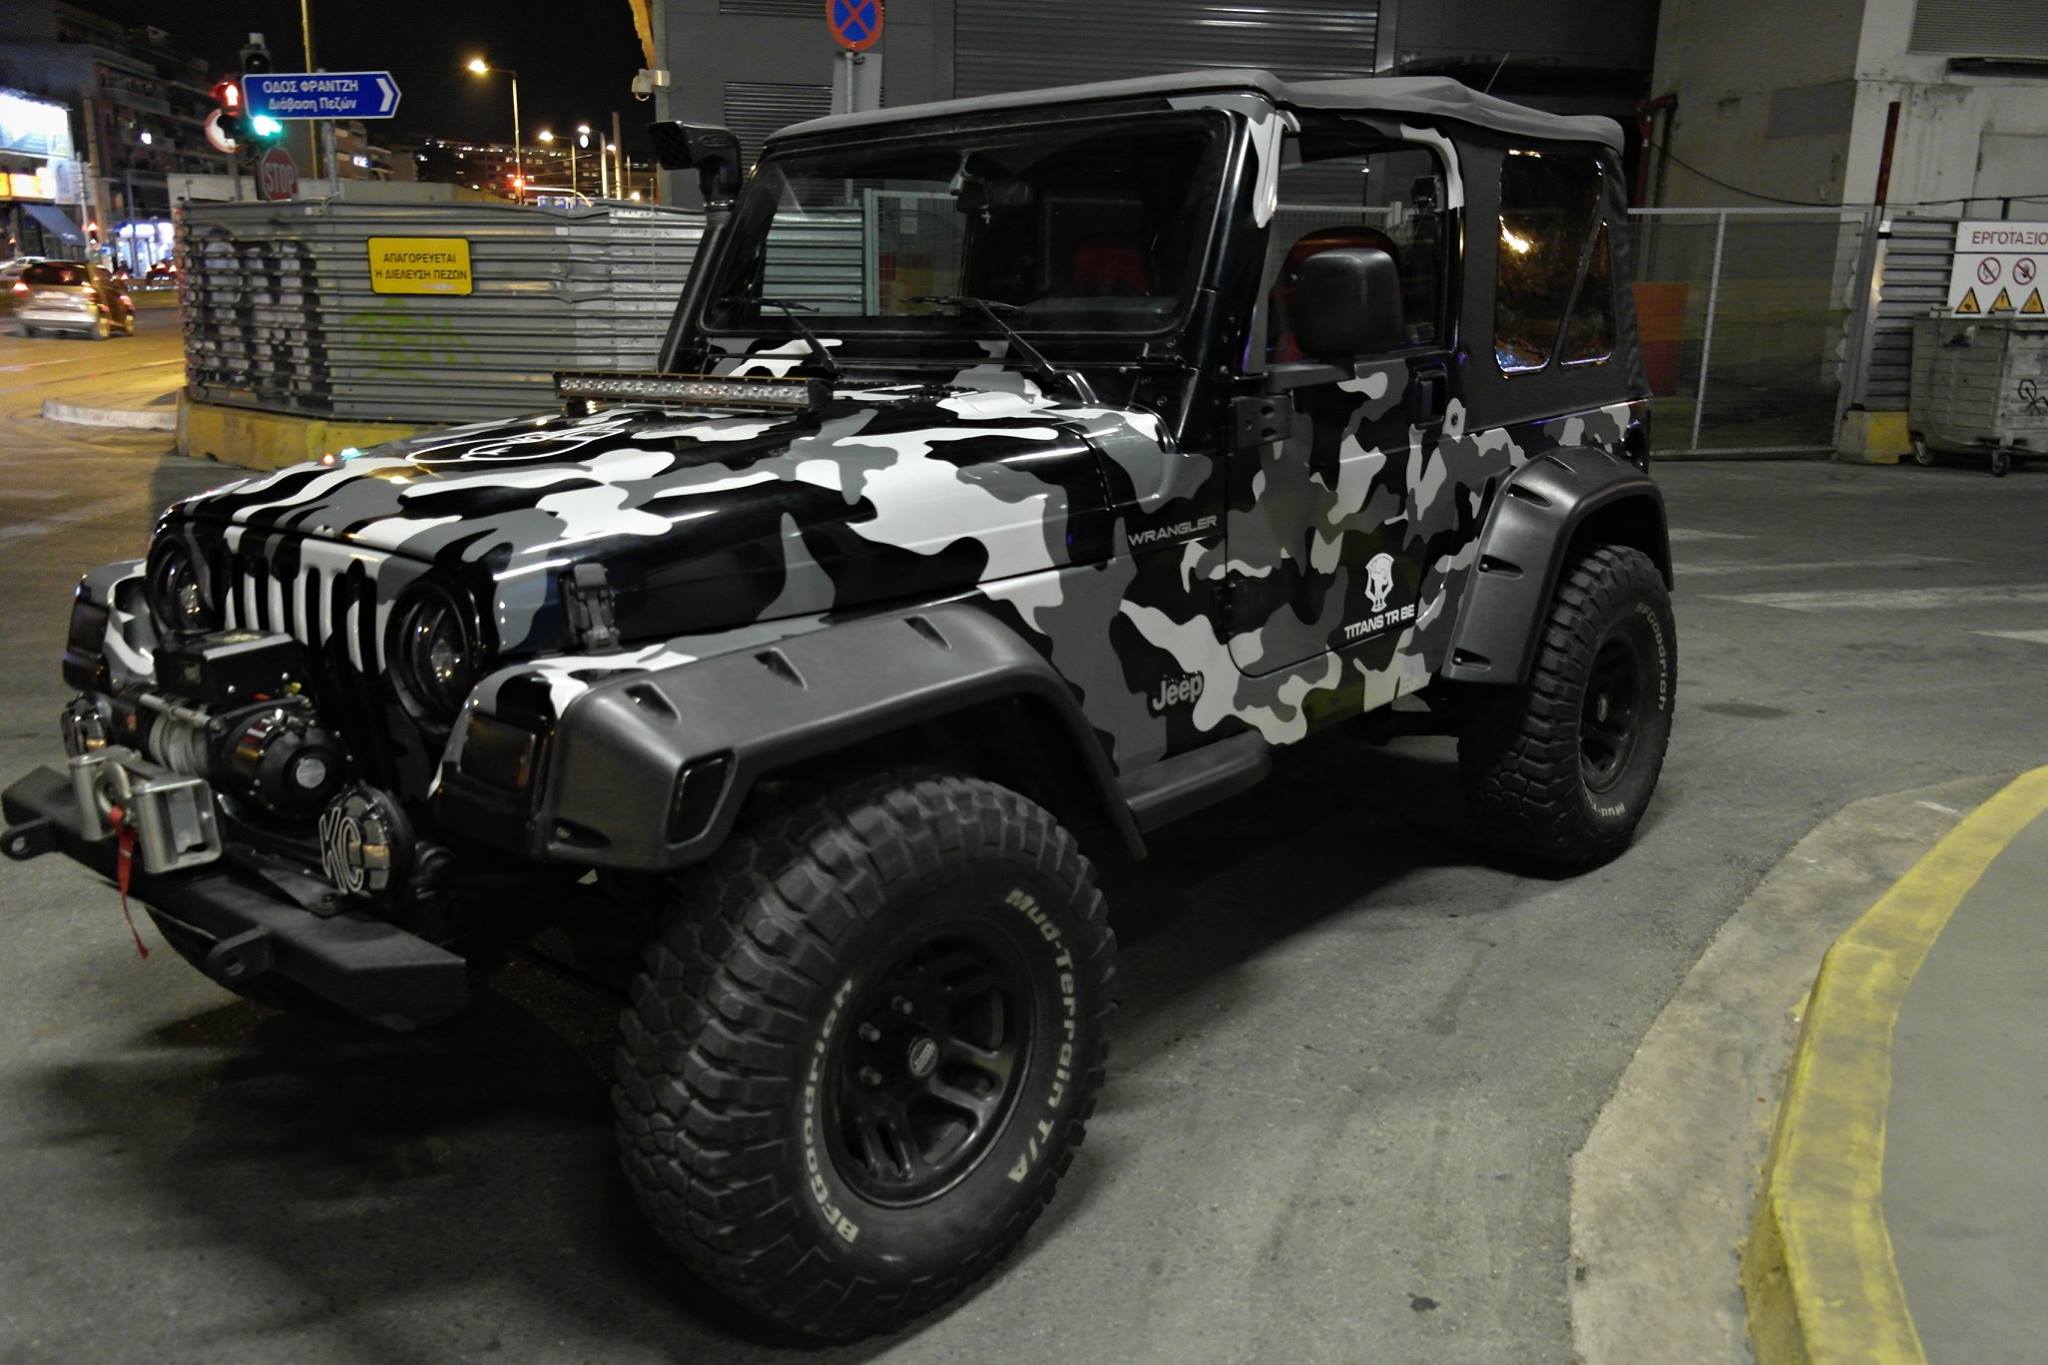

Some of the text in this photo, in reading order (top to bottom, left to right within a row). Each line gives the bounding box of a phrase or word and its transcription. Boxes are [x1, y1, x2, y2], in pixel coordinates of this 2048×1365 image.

[263, 80, 359, 93] ΟΔΟΣ ΦΡΑΝΤΖΗ
[268, 96, 357, 112] Διάβαση Πεζών
[264, 162, 295, 193] STOP
[1971, 231, 2048, 245] ΕΡΓΟΤΑΞΙΟ
[383, 253, 456, 264] ΑΠΑΓΟΡΕΥΕΤΑΙ
[375, 269, 468, 280] Η ΔΙΕΛΕΥΣΗ ΠΕΖΩΝ
[1128, 515, 1218, 546] WRANGLER
[1344, 613, 1385, 640] TITANS
[1152, 671, 1203, 711] Jeep
[318, 806, 364, 894] KC
[1005, 887, 1077, 1183] Mud-Terrain T/A
[804, 979, 860, 1244] BFGoodrich
